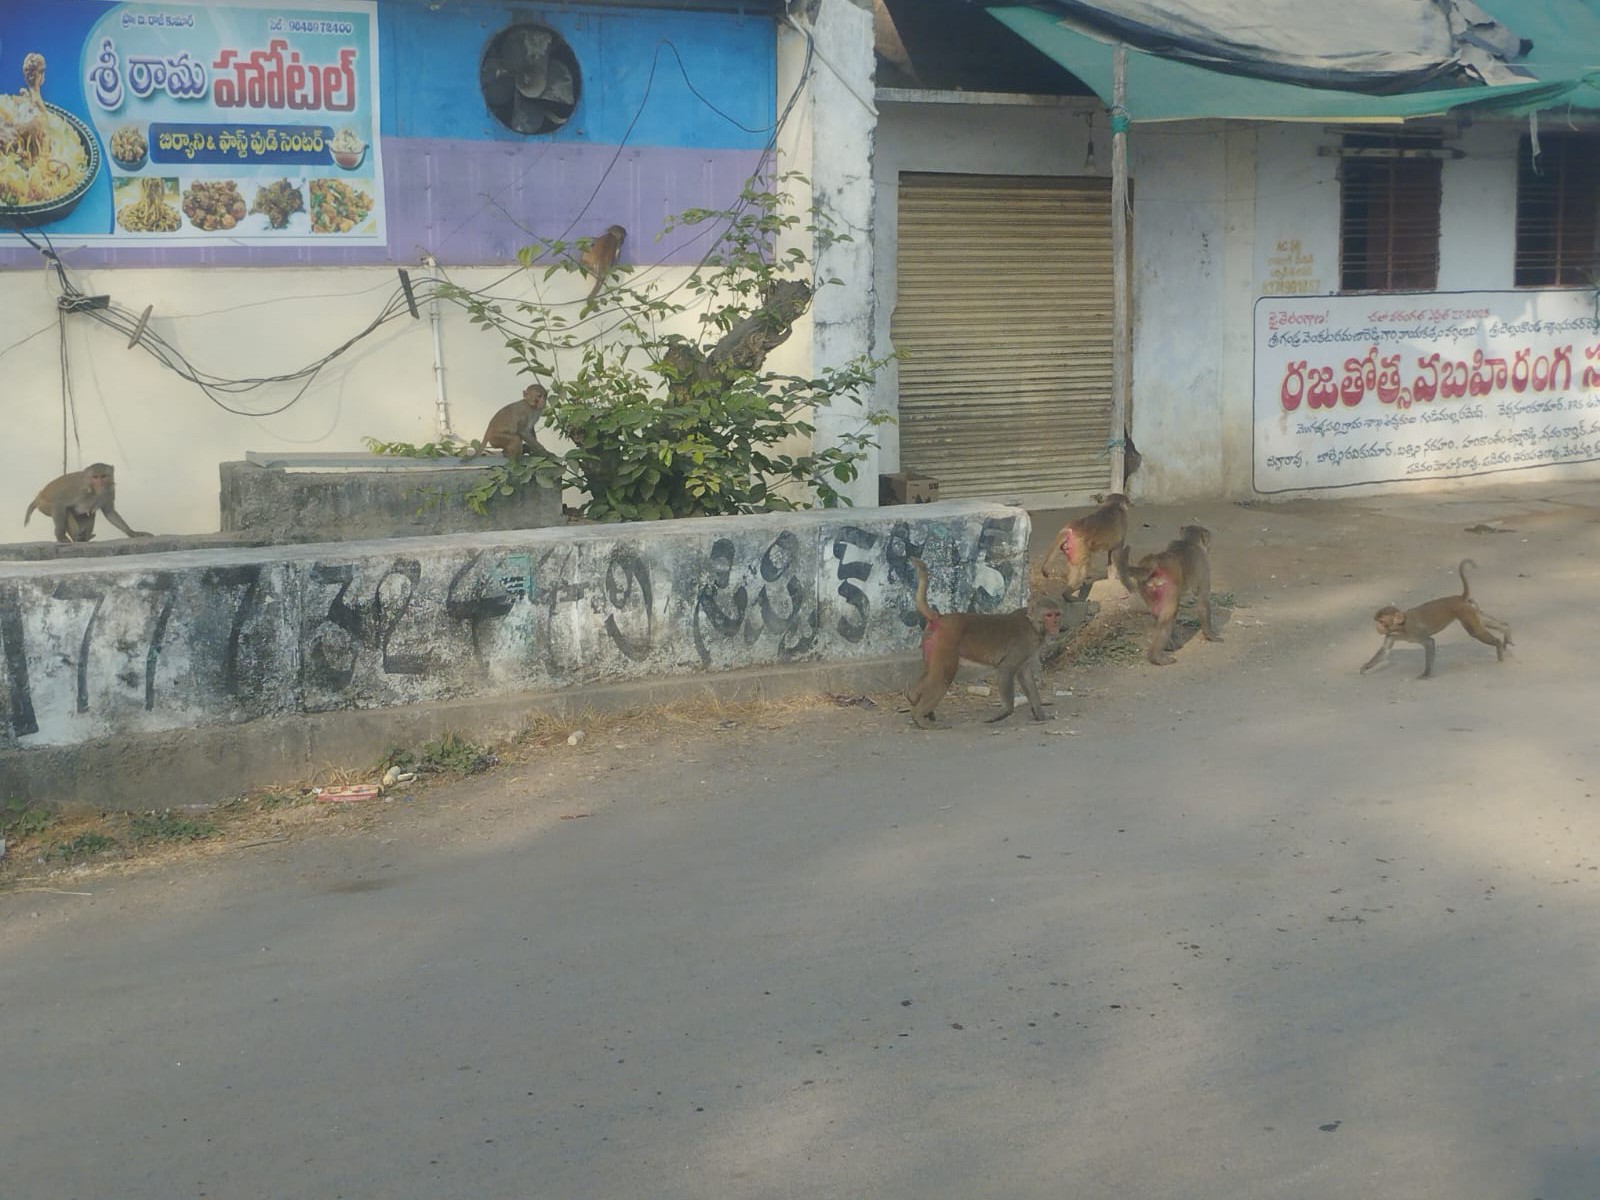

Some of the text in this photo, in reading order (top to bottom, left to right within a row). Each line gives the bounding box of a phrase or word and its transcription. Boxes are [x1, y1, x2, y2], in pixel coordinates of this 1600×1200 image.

[90, 38, 357, 112] శ్రీ రామ హోటల్
[159, 131, 206, 159] బిర్యాని
[279, 128, 324, 153] సెంటర్
